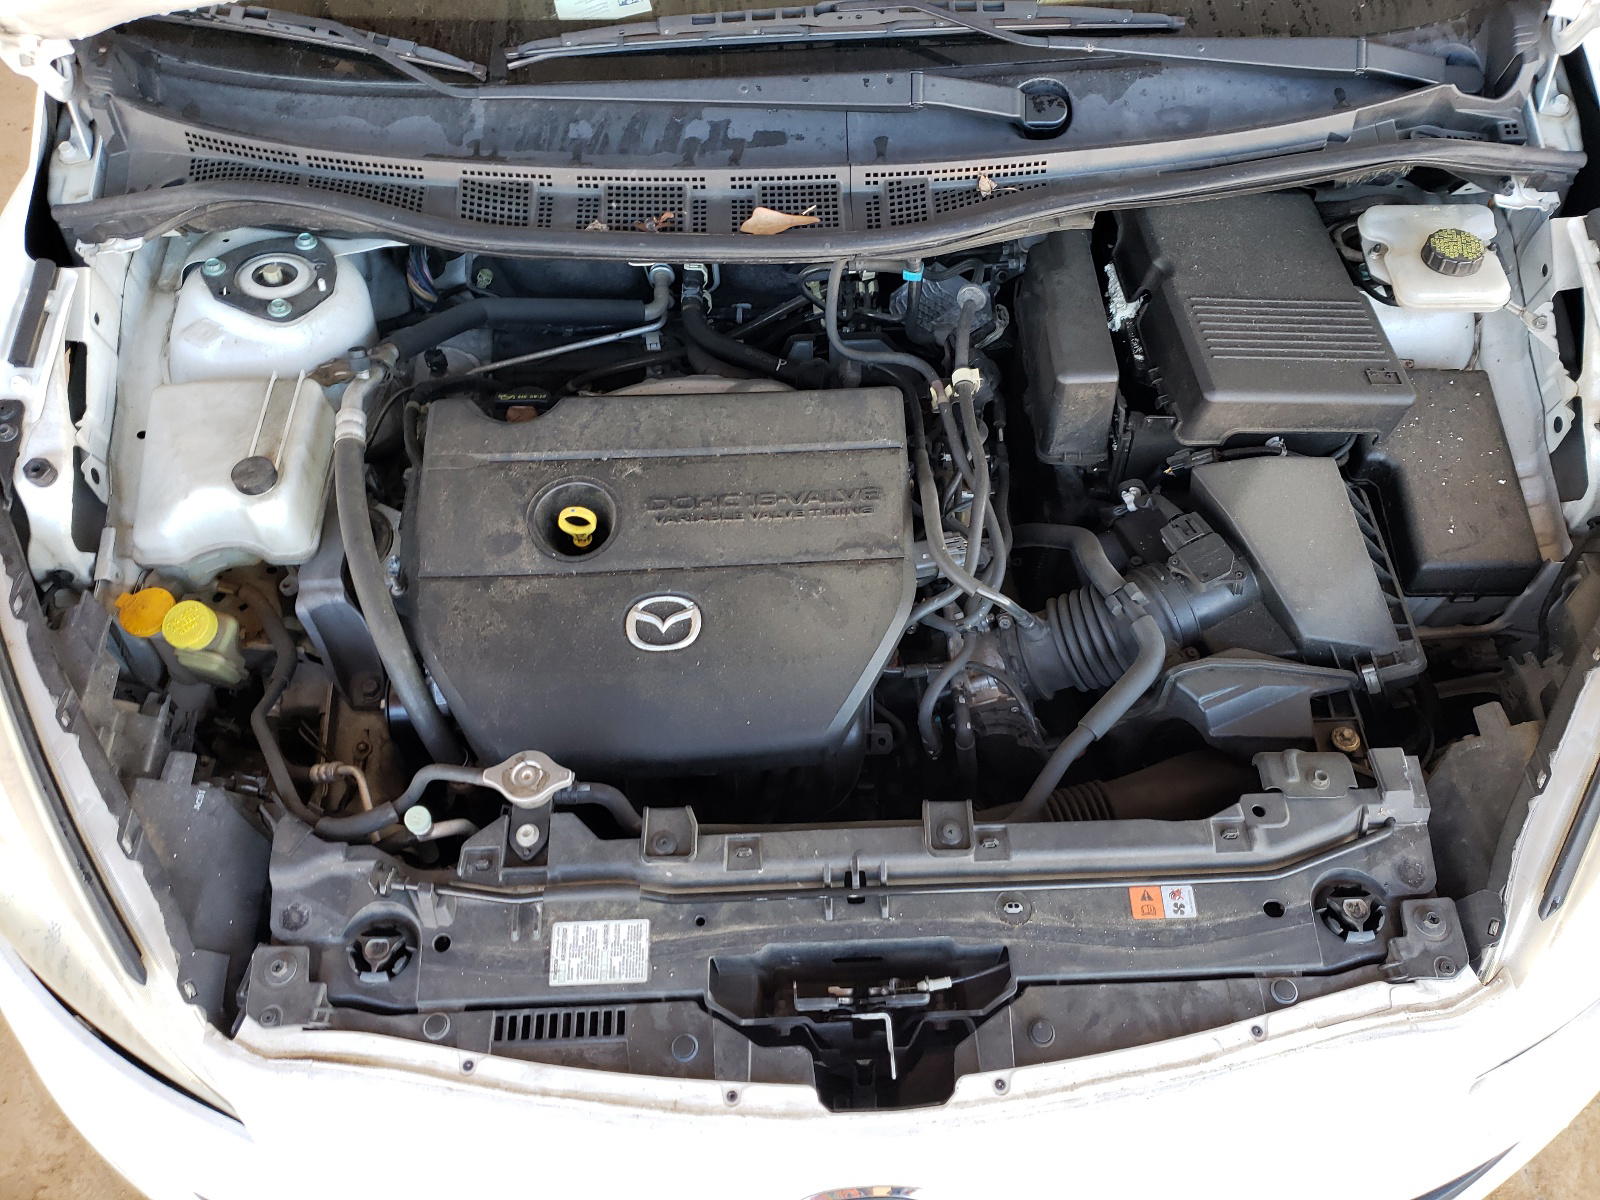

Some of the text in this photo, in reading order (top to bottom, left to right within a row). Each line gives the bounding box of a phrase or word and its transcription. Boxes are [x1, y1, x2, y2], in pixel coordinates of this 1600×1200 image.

[647, 491, 743, 512] DOHC
[655, 510, 745, 525] VARIABLE
[750, 508, 806, 523] VALVE
